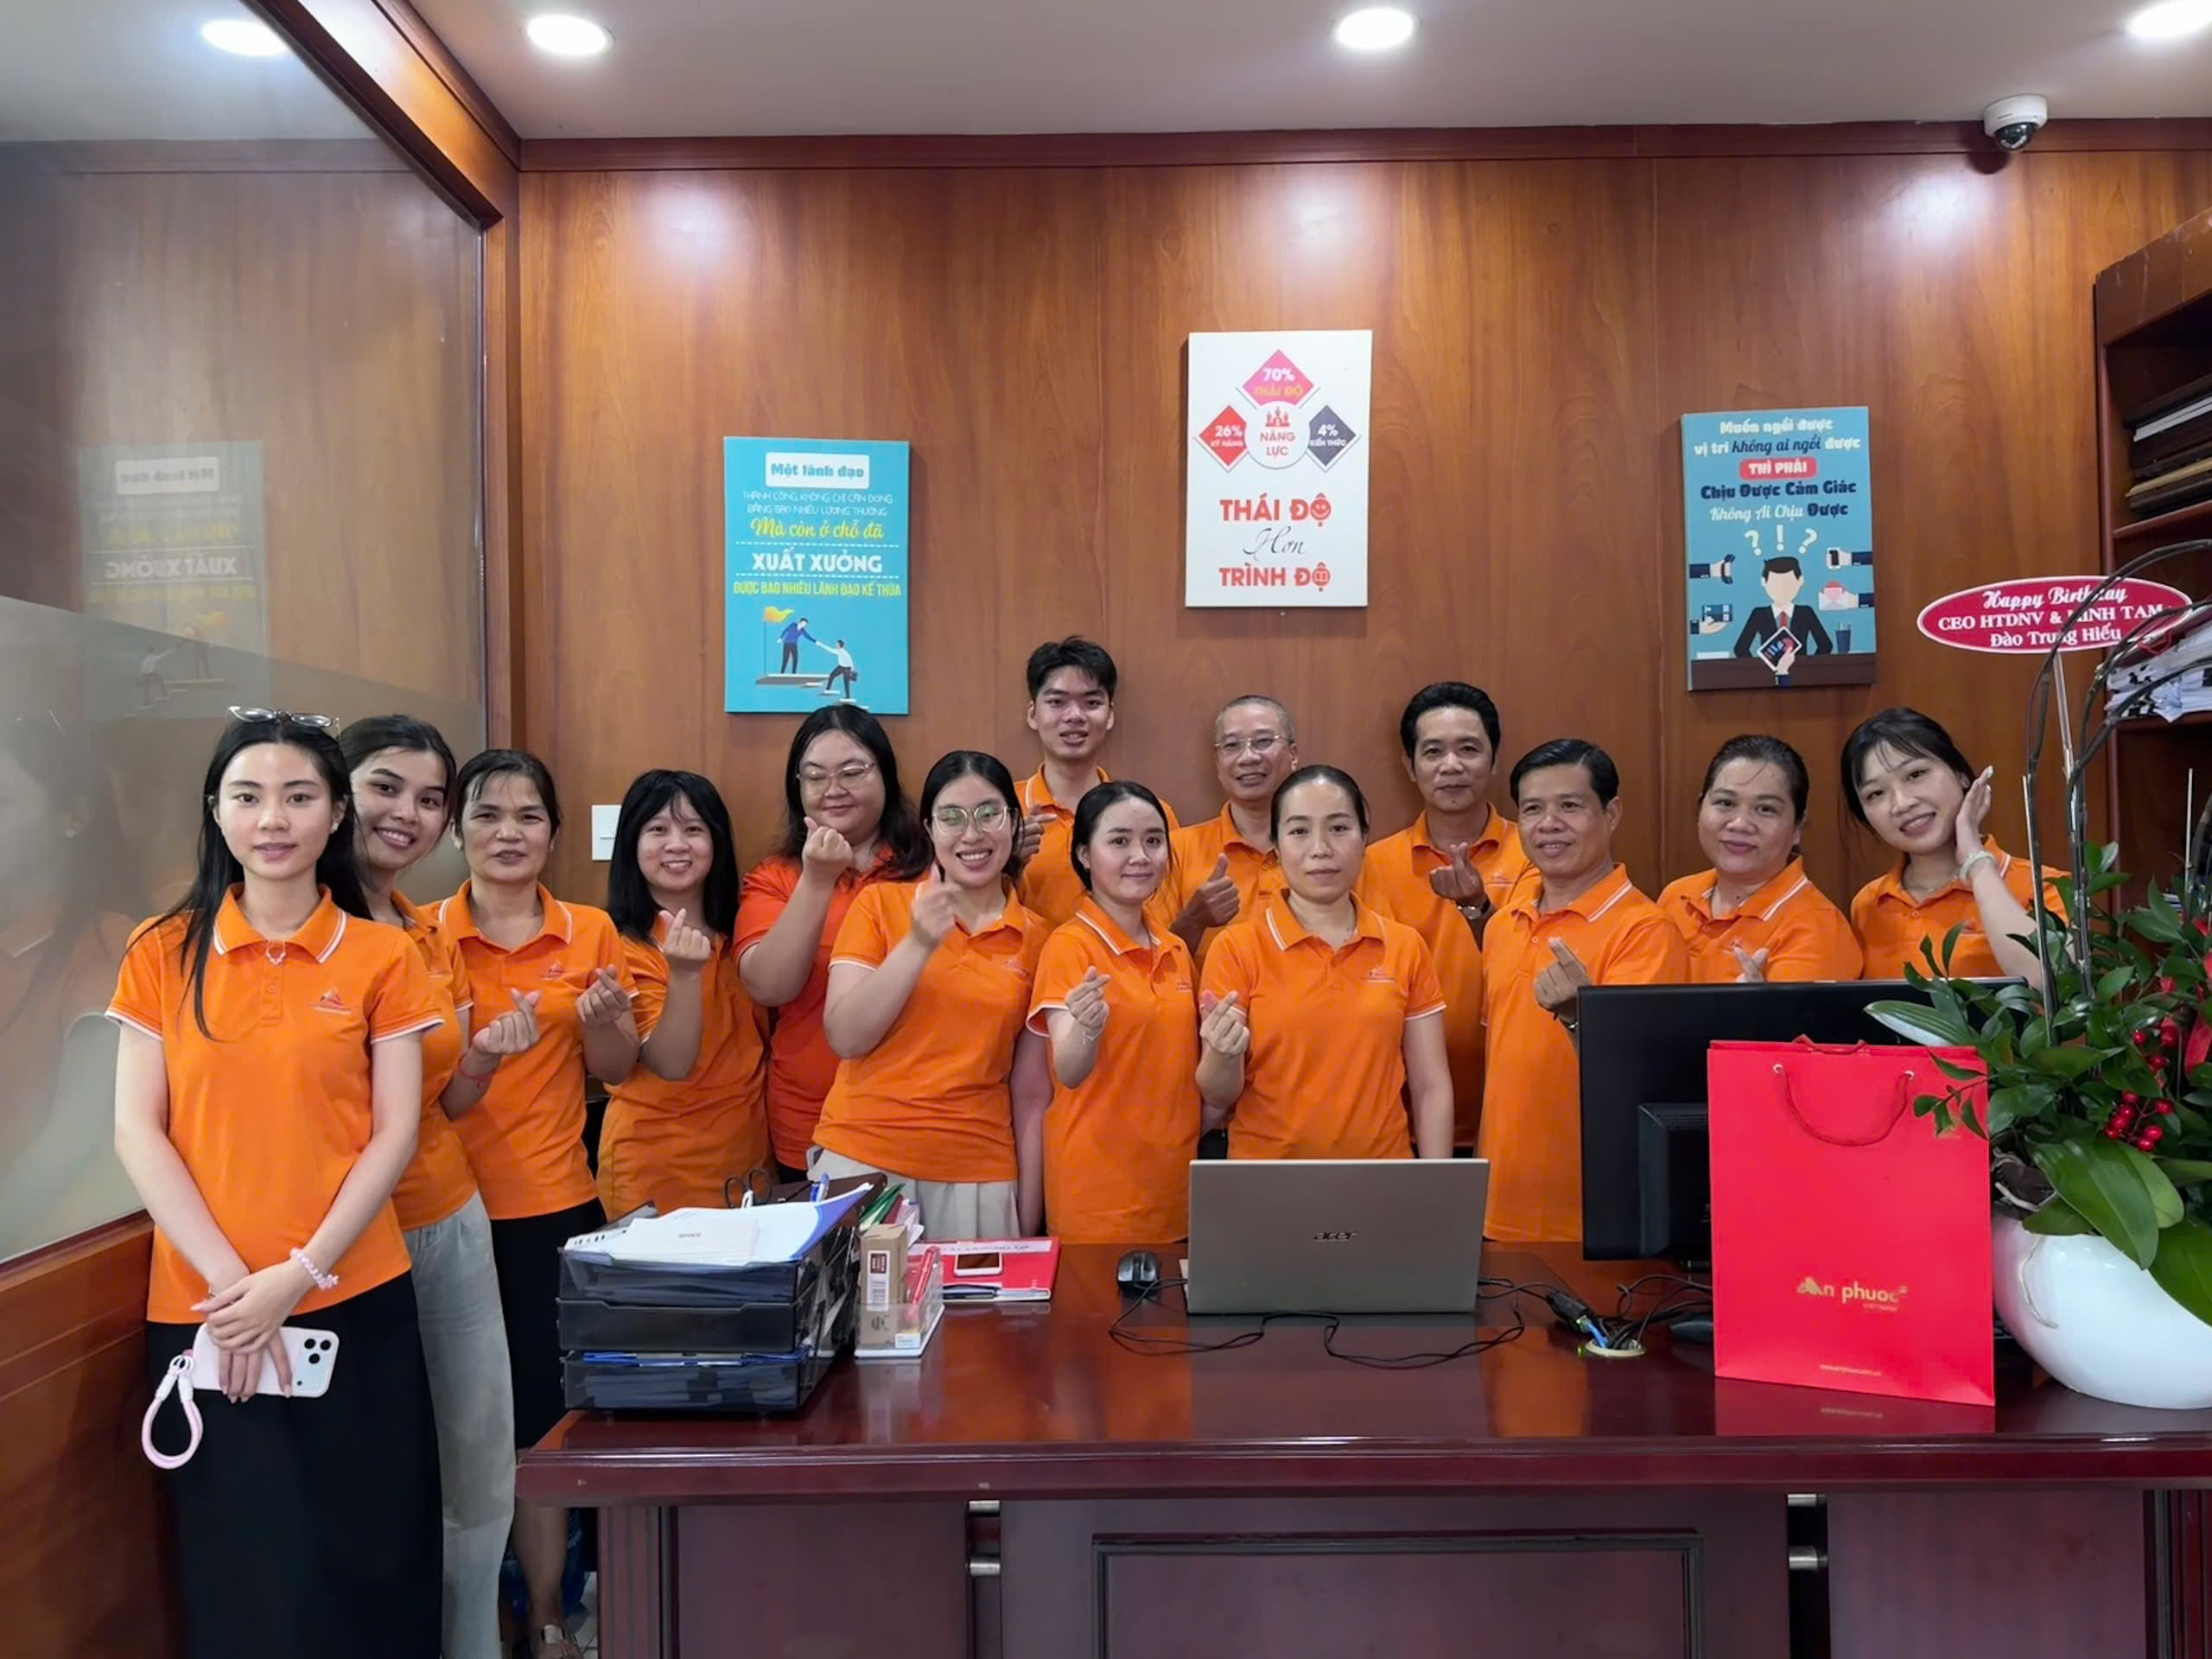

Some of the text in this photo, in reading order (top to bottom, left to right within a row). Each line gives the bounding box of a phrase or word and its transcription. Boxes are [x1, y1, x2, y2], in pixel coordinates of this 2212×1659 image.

[1262, 368, 1294, 382] 70%
[1214, 424, 1243, 438] 26%
[1259, 429, 1296, 442] NĂNG
[1317, 423, 1339, 437] 4%
[1719, 418, 1759, 435] Muốn
[1797, 418, 1834, 434] được
[1266, 444, 1289, 459] LỰC
[1694, 435, 1861, 457] vị trí không ai ngồi được
[771, 463, 798, 479] Một
[837, 466, 865, 480] đạo
[1749, 458, 1807, 474] THÌ PHẢI
[1700, 480, 1857, 500] Chịu Được Cảm Giác
[1219, 493, 1332, 527] THÁI ĐỘ
[1710, 503, 1849, 524] Không Ai Chịu Được
[750, 517, 786, 538] Mà
[789, 519, 817, 538] còn
[862, 520, 884, 539] đã
[1243, 525, 1305, 562] Hơn
[752, 545, 805, 571] XUẤT
[1218, 562, 1286, 587] TRÌNH
[760, 580, 781, 595] BAO
[1982, 590, 2045, 611] Happy
[1938, 615, 1976, 631] CEO
[1980, 612, 2045, 628] HTDNV
[2050, 610, 2063, 625] &
[1990, 631, 2024, 647] Đào
[2082, 622, 2123, 642] Hiếu
[1314, 1230, 1359, 1242] acer
